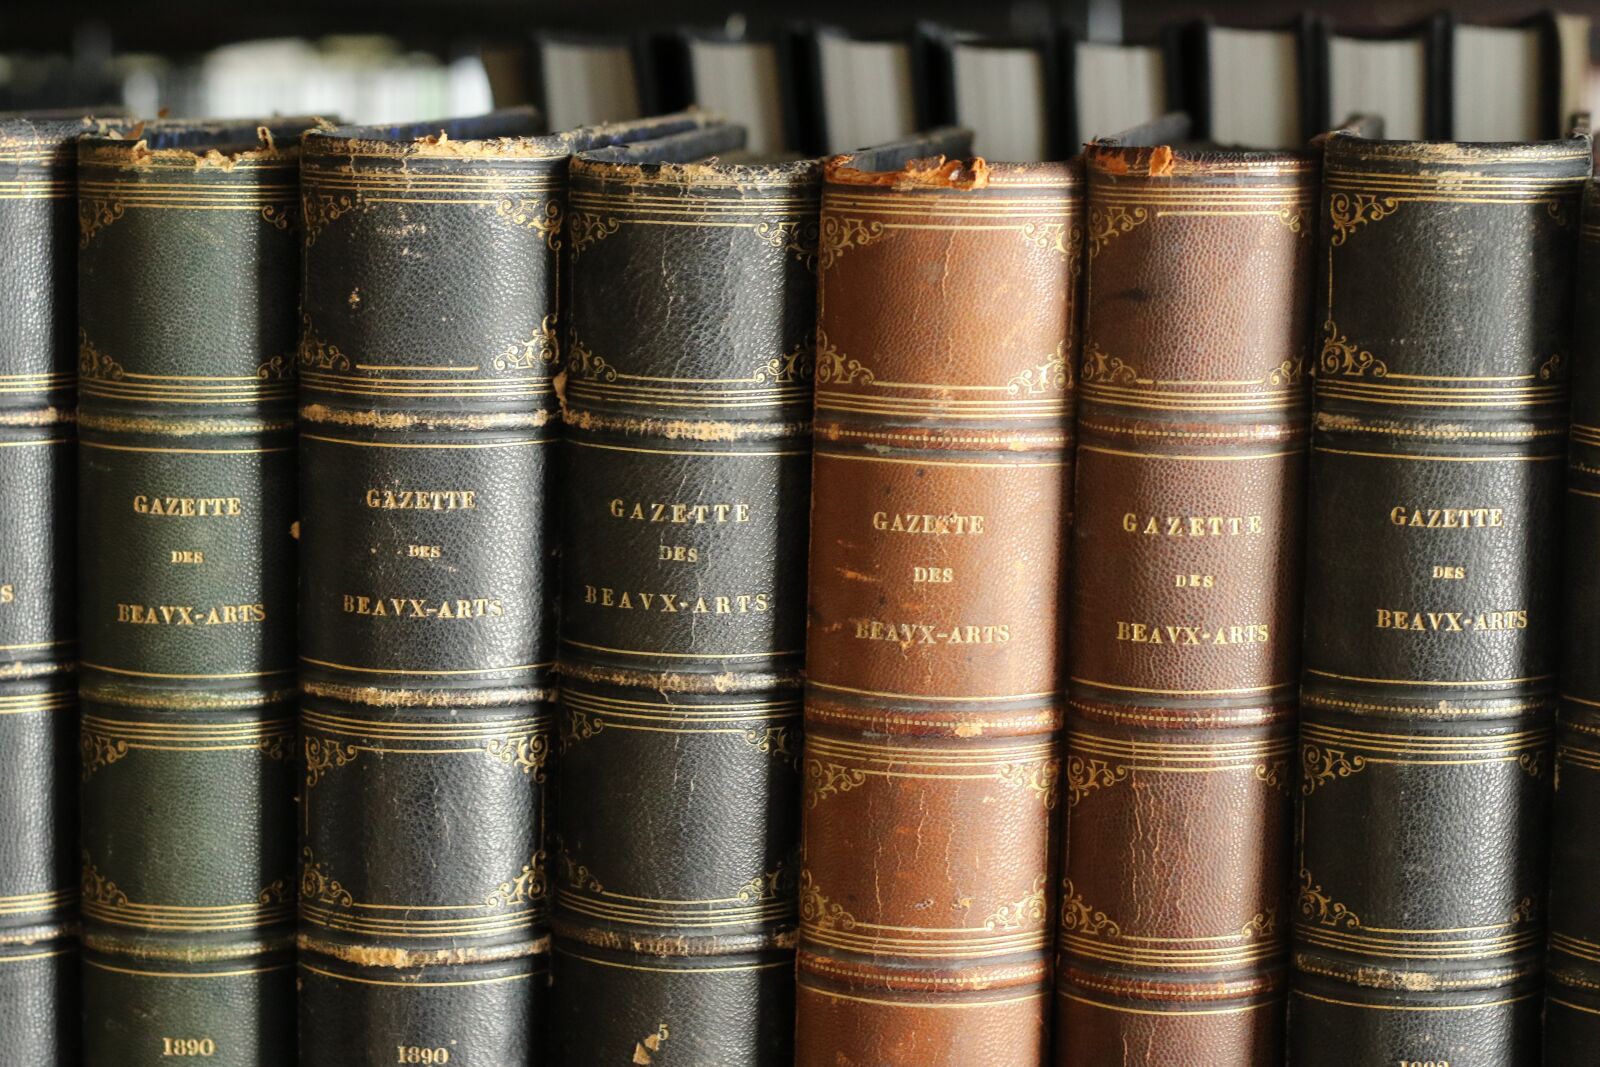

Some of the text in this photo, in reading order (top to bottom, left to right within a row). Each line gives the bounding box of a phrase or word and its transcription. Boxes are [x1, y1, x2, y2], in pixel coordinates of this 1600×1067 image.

[133, 495, 242, 517] GAZETTE
[365, 489, 475, 510] GAZETTE
[610, 499, 750, 523] GAZETTE
[1390, 506, 1504, 528] GAZETTE
[873, 512, 985, 535] GAZETTE
[1122, 513, 1262, 537] GAZETTE
[171, 551, 205, 564] DES
[408, 545, 441, 558] DES
[658, 545, 698, 563] DES
[913, 567, 953, 583] DES
[1175, 574, 1214, 588] DES
[1432, 566, 1465, 580] DES
[343, 595, 502, 620] BEAVX-ARTS
[584, 585, 770, 615] BEAVX-ARTS
[118, 603, 266, 626] BEAVX-ARTS
[1376, 608, 1528, 632] BEAVX-ARTS
[855, 618, 1011, 643] BEAVX-ARTS
[1116, 621, 1269, 645] BEAVX-ARTS
[163, 1037, 215, 1057] 1890
[397, 1045, 449, 1065] 1890
